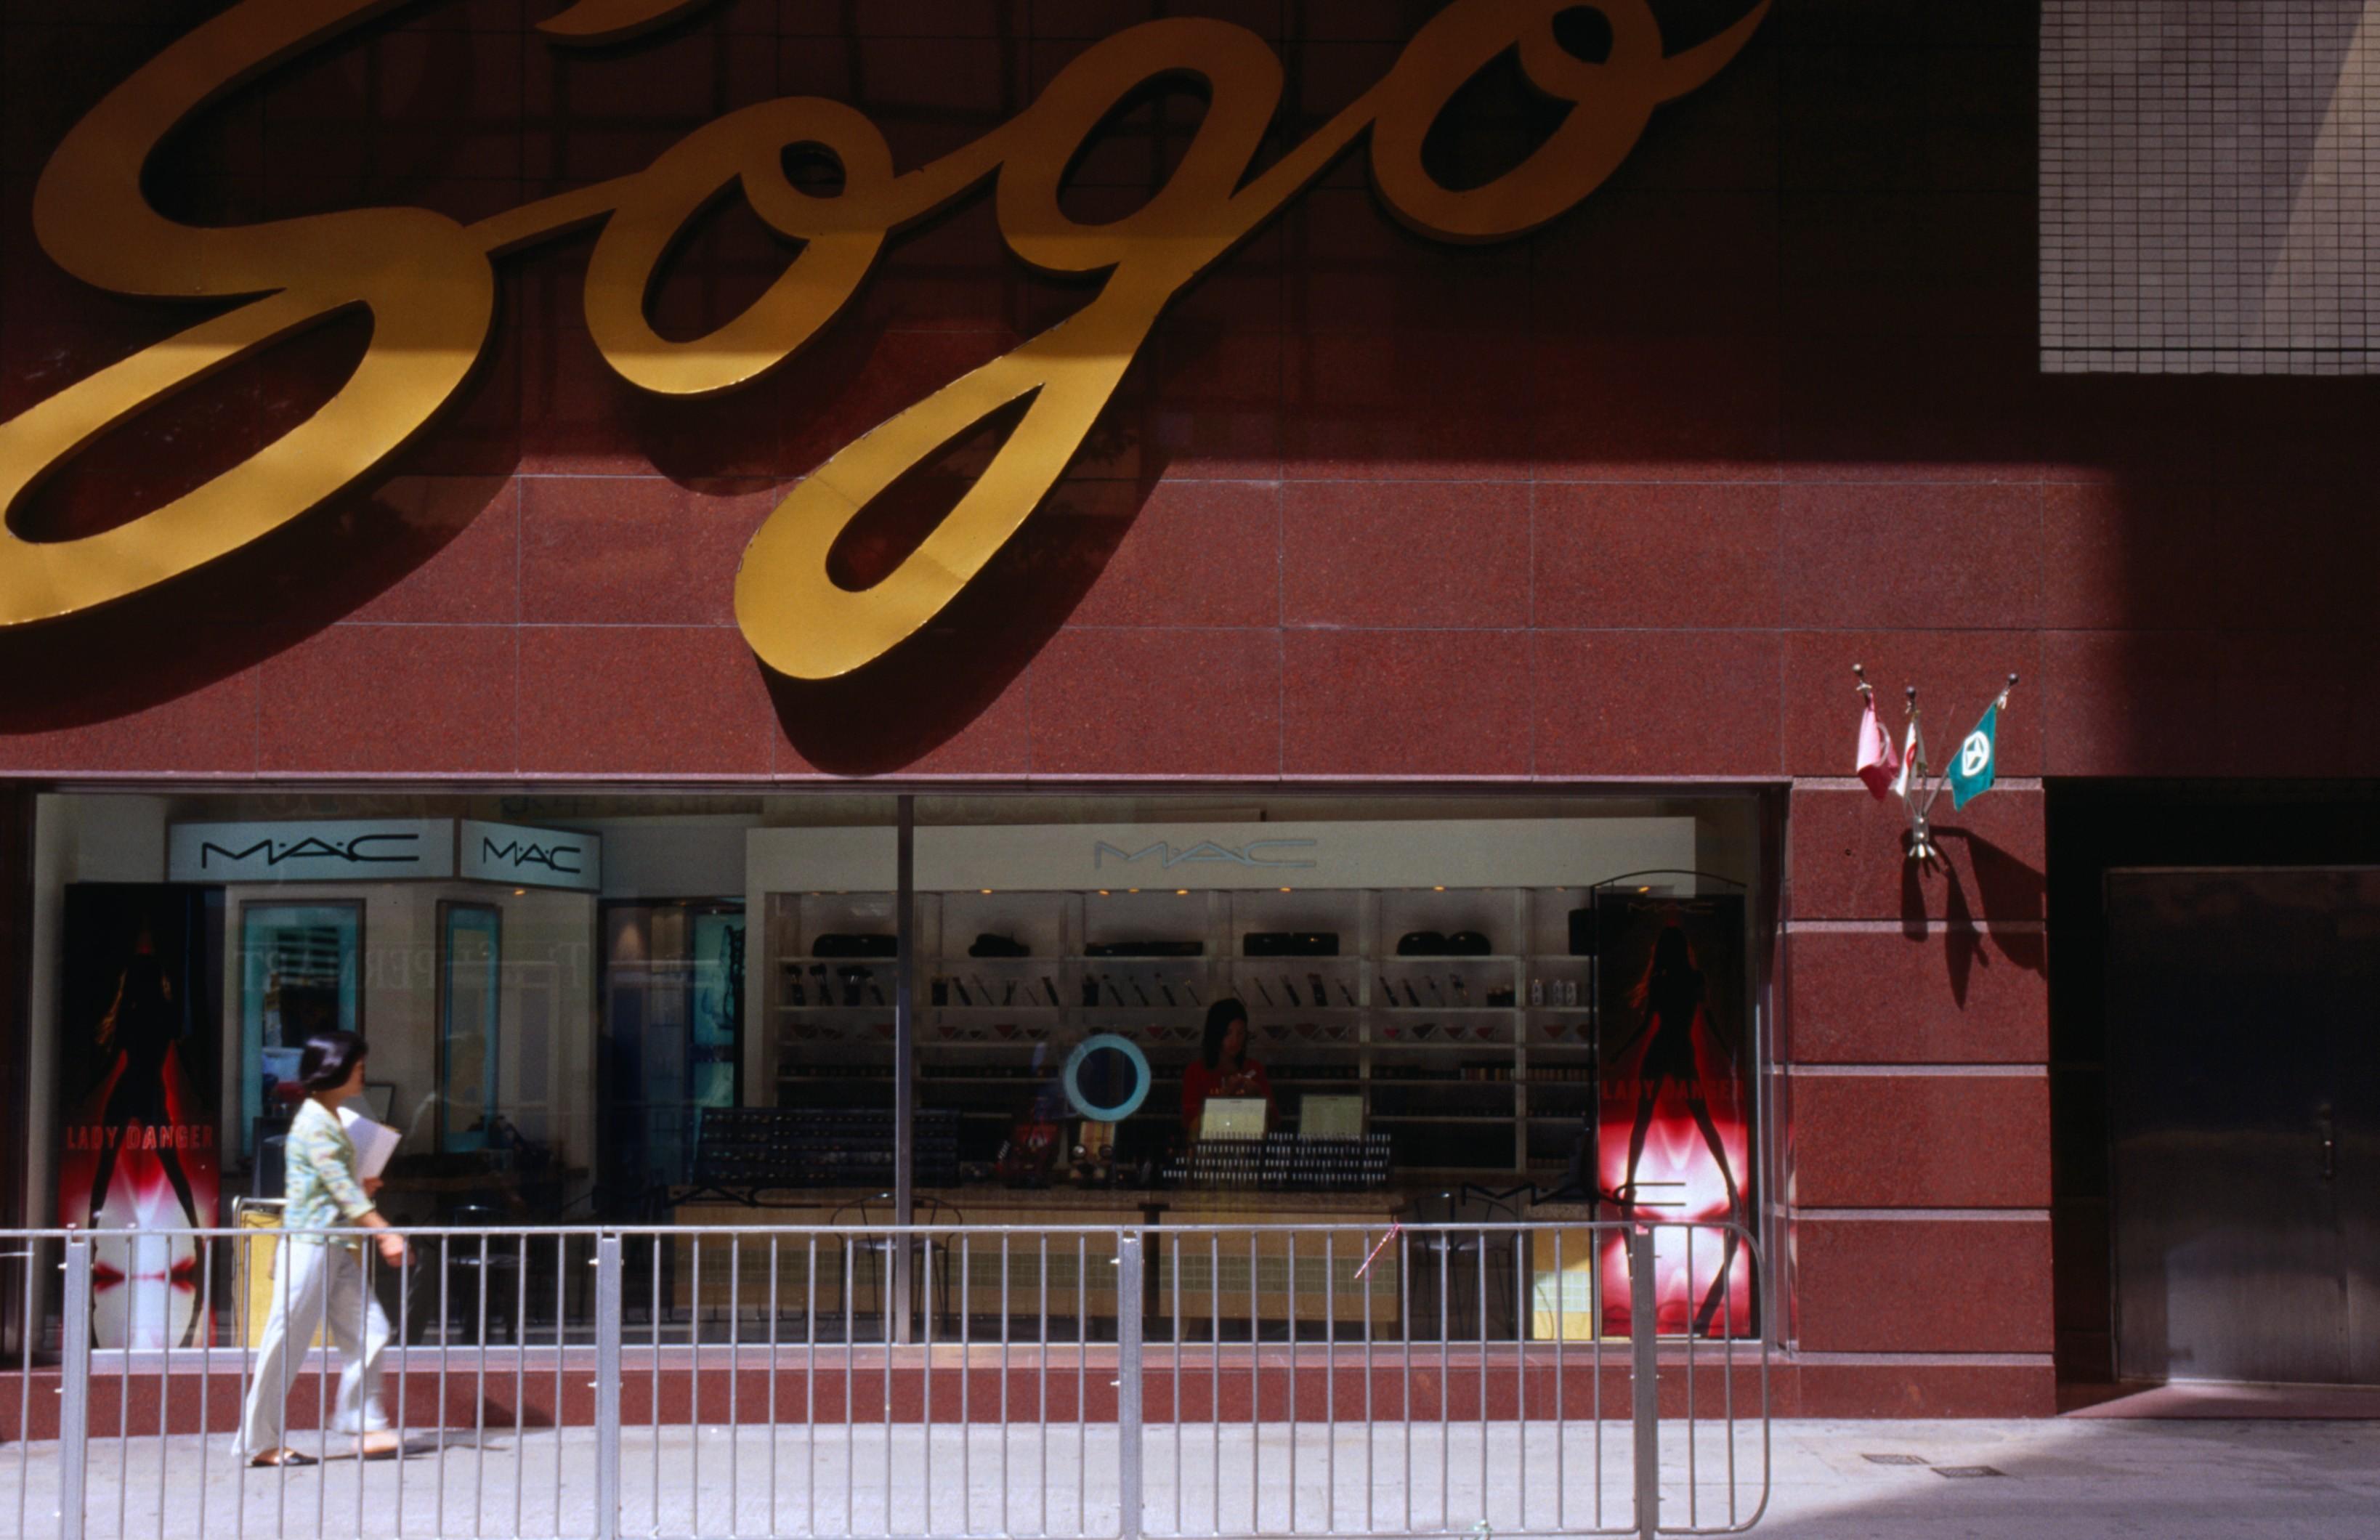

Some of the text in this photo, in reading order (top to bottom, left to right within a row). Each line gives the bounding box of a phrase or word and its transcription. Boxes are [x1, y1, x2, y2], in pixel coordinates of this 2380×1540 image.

[0, 0, 1773, 681] Sogo
[1601, 1079, 1745, 1101] LADY DANGER
[66, 1124, 214, 1151] LADY DANGER
